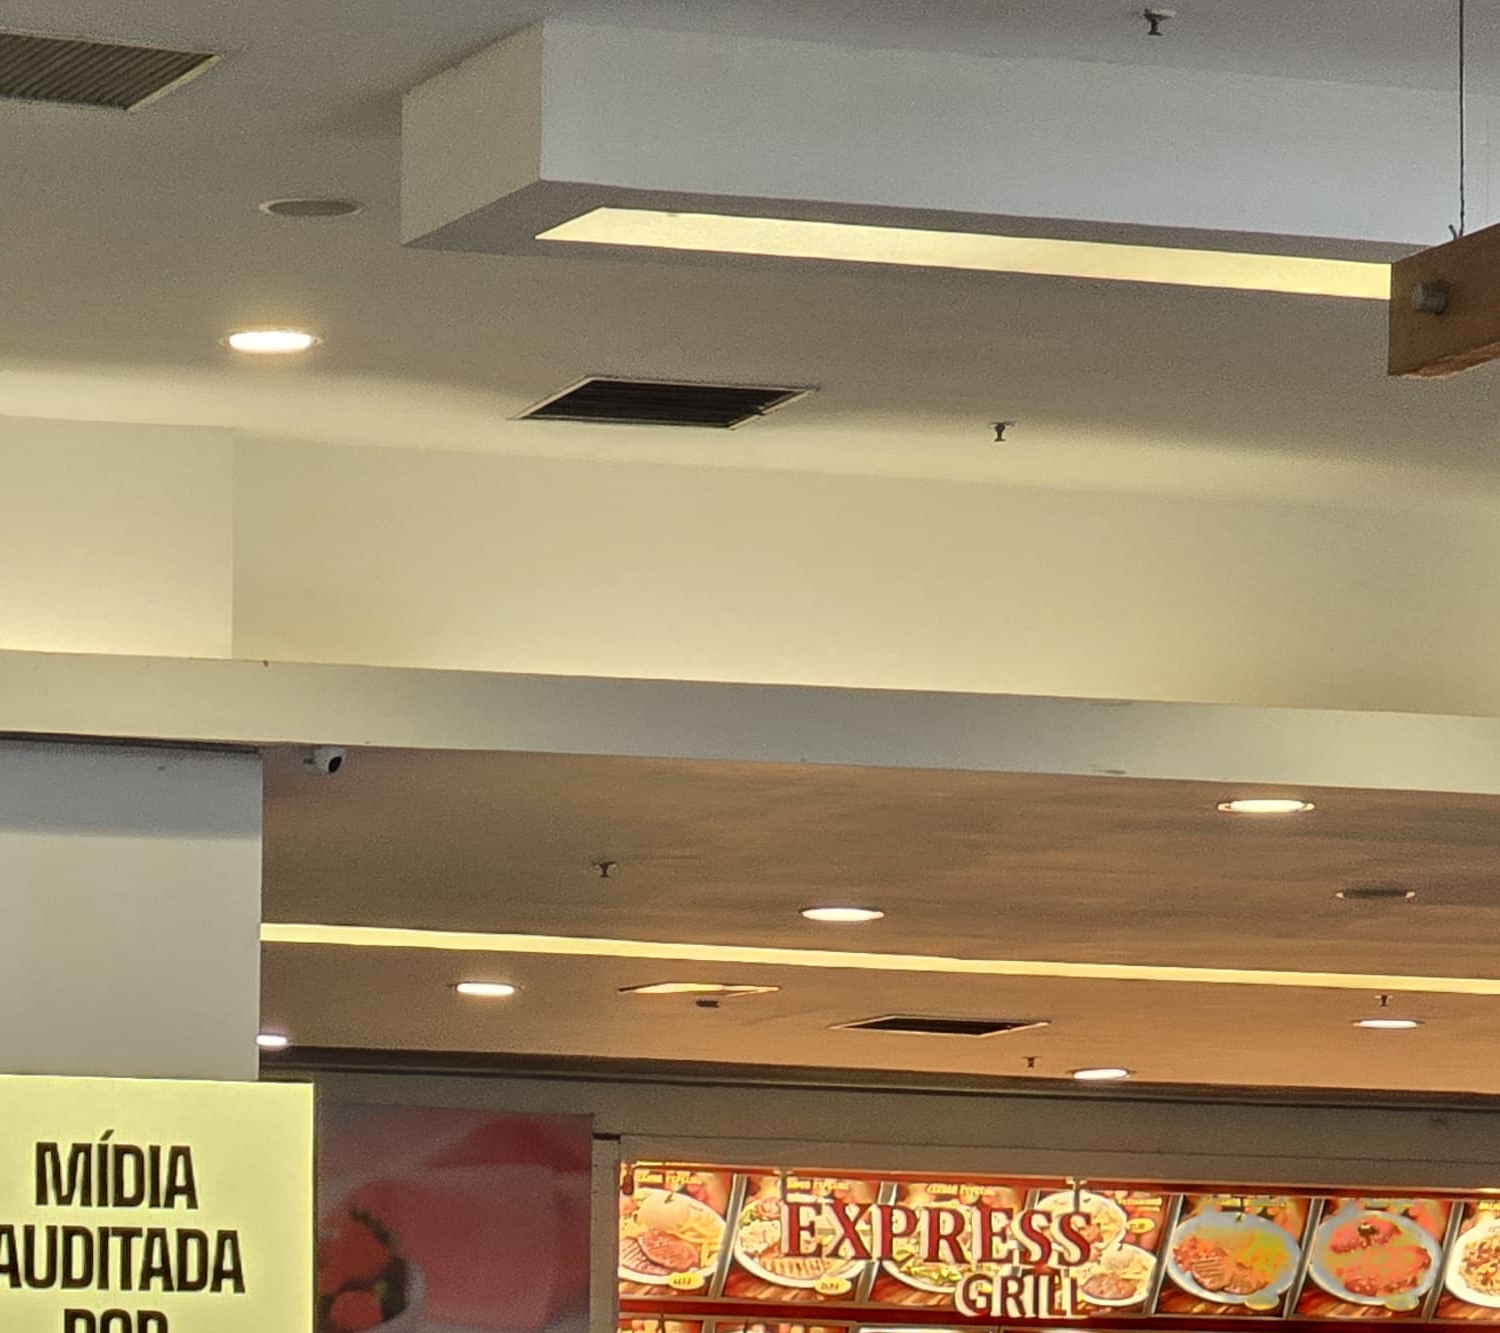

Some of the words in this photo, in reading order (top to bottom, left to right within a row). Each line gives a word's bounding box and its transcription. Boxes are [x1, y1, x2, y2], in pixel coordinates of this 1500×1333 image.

[35, 1129, 199, 1210] MÍDIA
[784, 1198, 1092, 1269] EXPRESS
[955, 1272, 1092, 1320] GRILL
